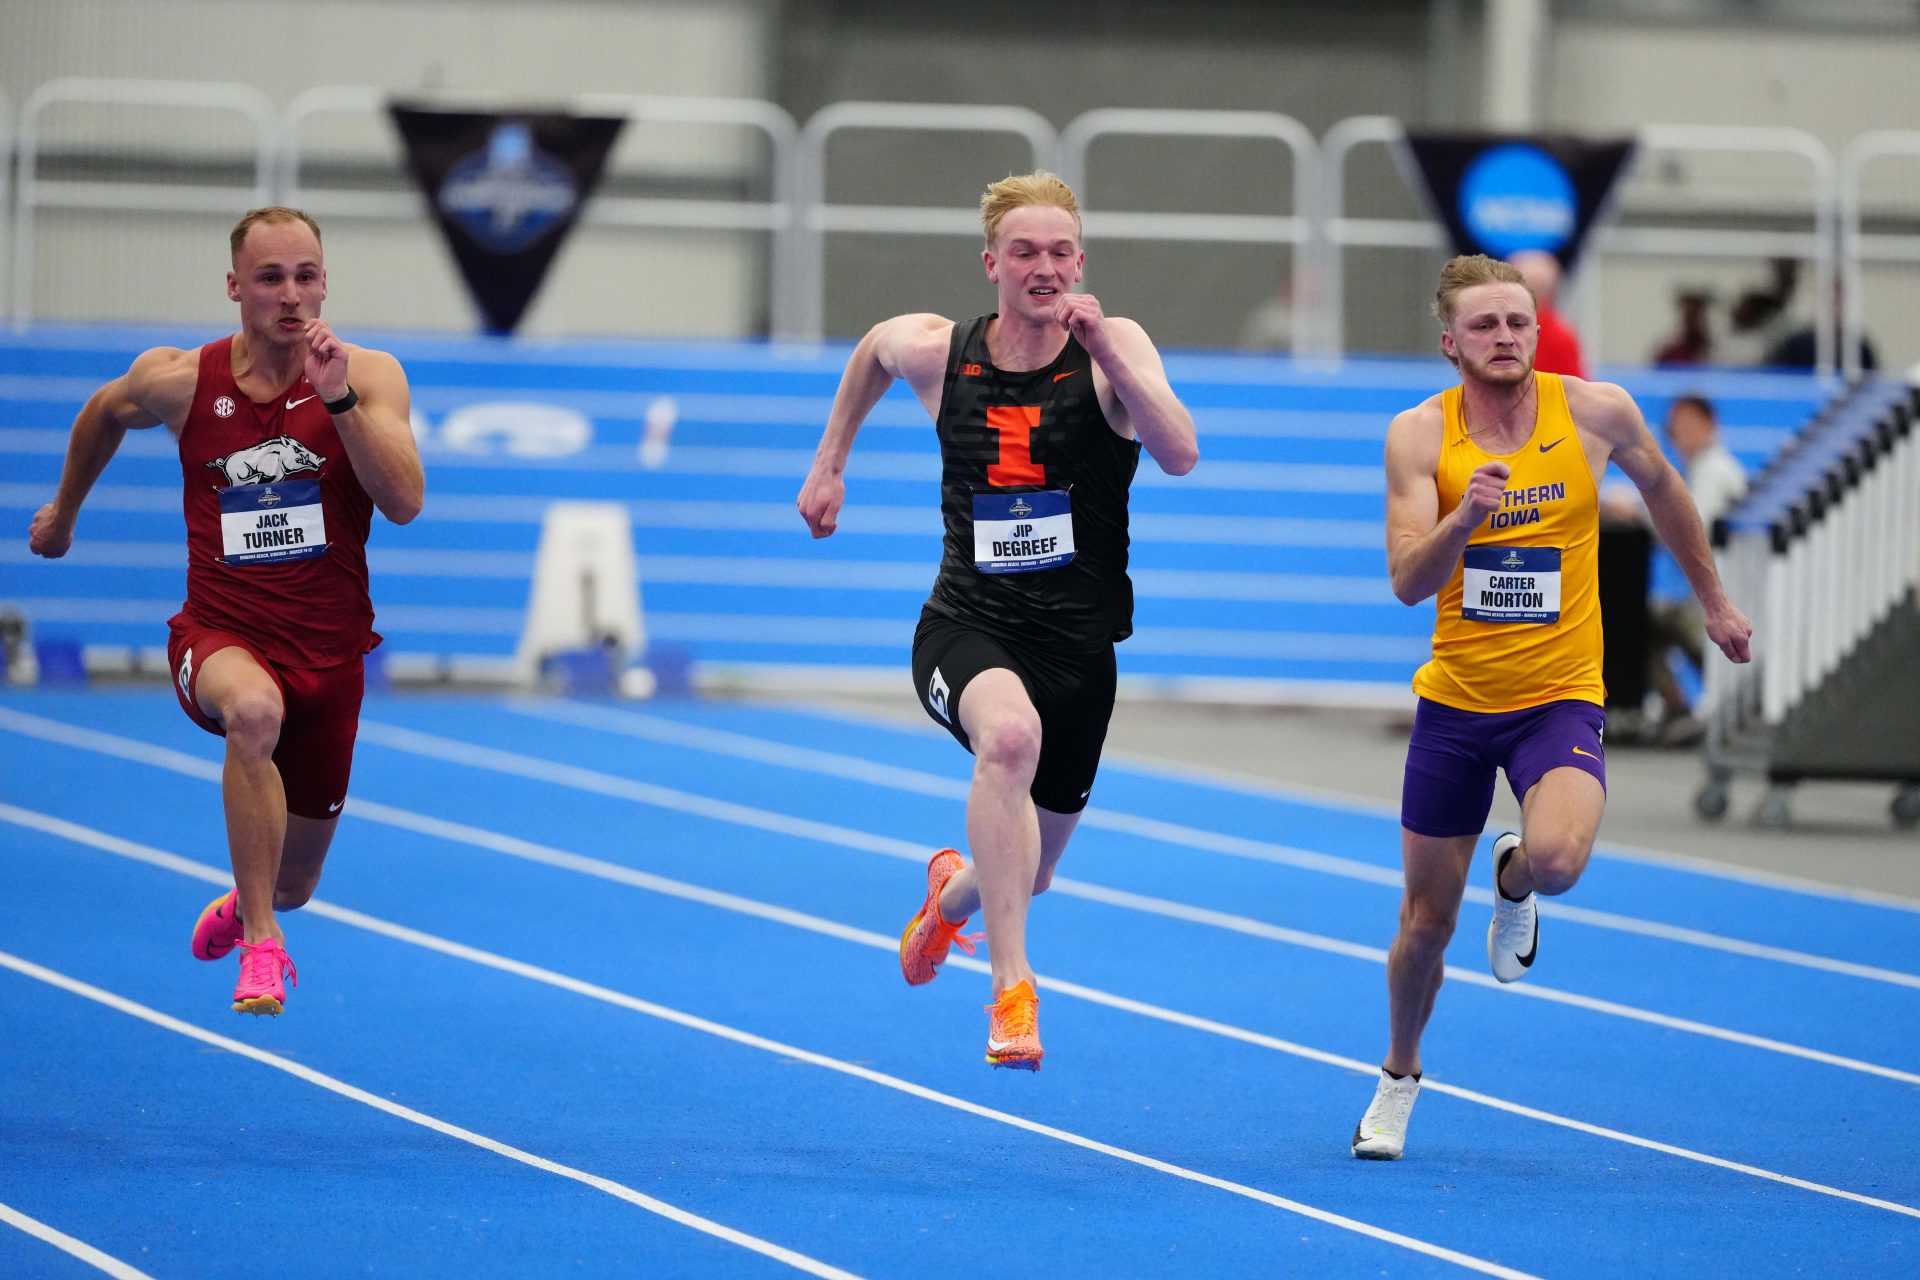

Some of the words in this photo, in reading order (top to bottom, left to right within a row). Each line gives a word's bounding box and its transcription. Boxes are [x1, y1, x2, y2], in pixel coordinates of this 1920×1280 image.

[216, 398, 234, 417] SEC
[986, 406, 1046, 486] I
[256, 513, 288, 528] JACK
[1490, 508, 1540, 529] IOWA
[243, 528, 304, 549] TURNER
[1013, 525, 1032, 538] JIP
[993, 537, 1058, 557] DEGREEF
[1490, 576, 1534, 590] CARTER
[1480, 591, 1542, 608] MORTON
